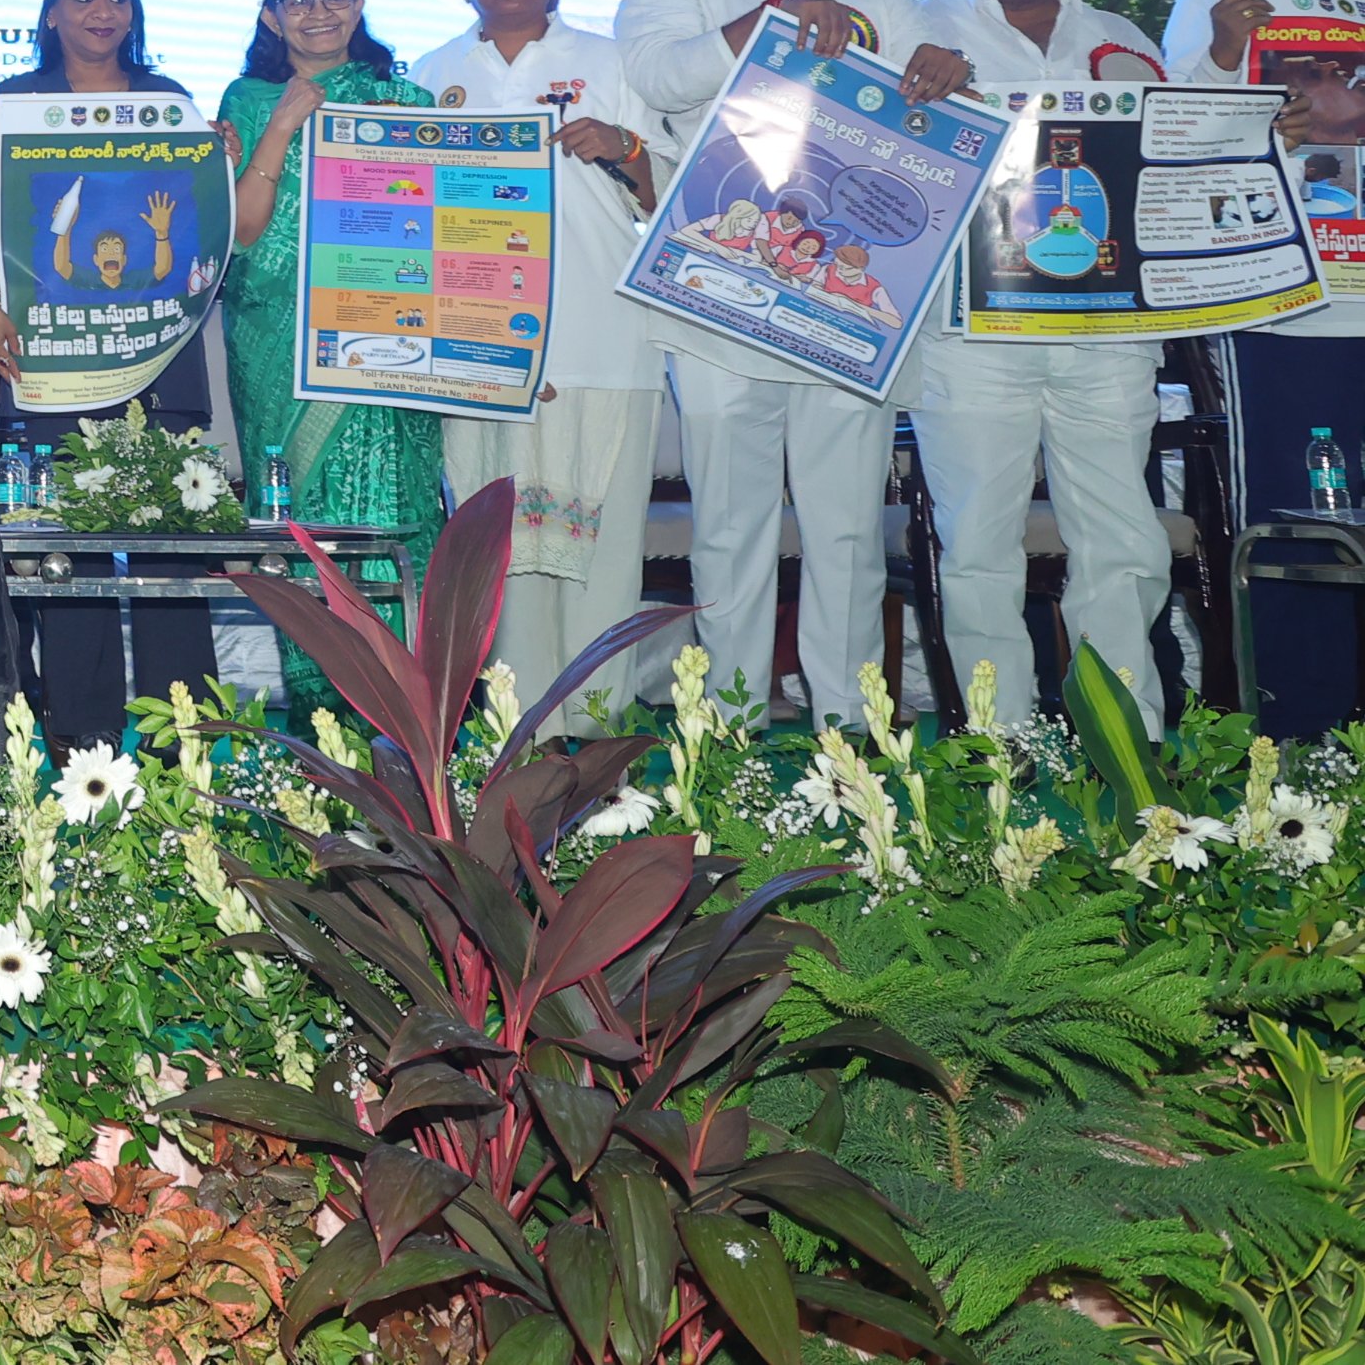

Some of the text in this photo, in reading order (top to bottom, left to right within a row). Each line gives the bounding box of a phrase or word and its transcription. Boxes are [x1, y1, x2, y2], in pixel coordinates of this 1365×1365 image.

[11, 141, 213, 163] తెలంగాణ యాంటీ బ్యూరో
[1211, 235, 1250, 244] BANNED
[1263, 227, 1289, 238] INDIA
[1273, 294, 1317, 313] 1908
